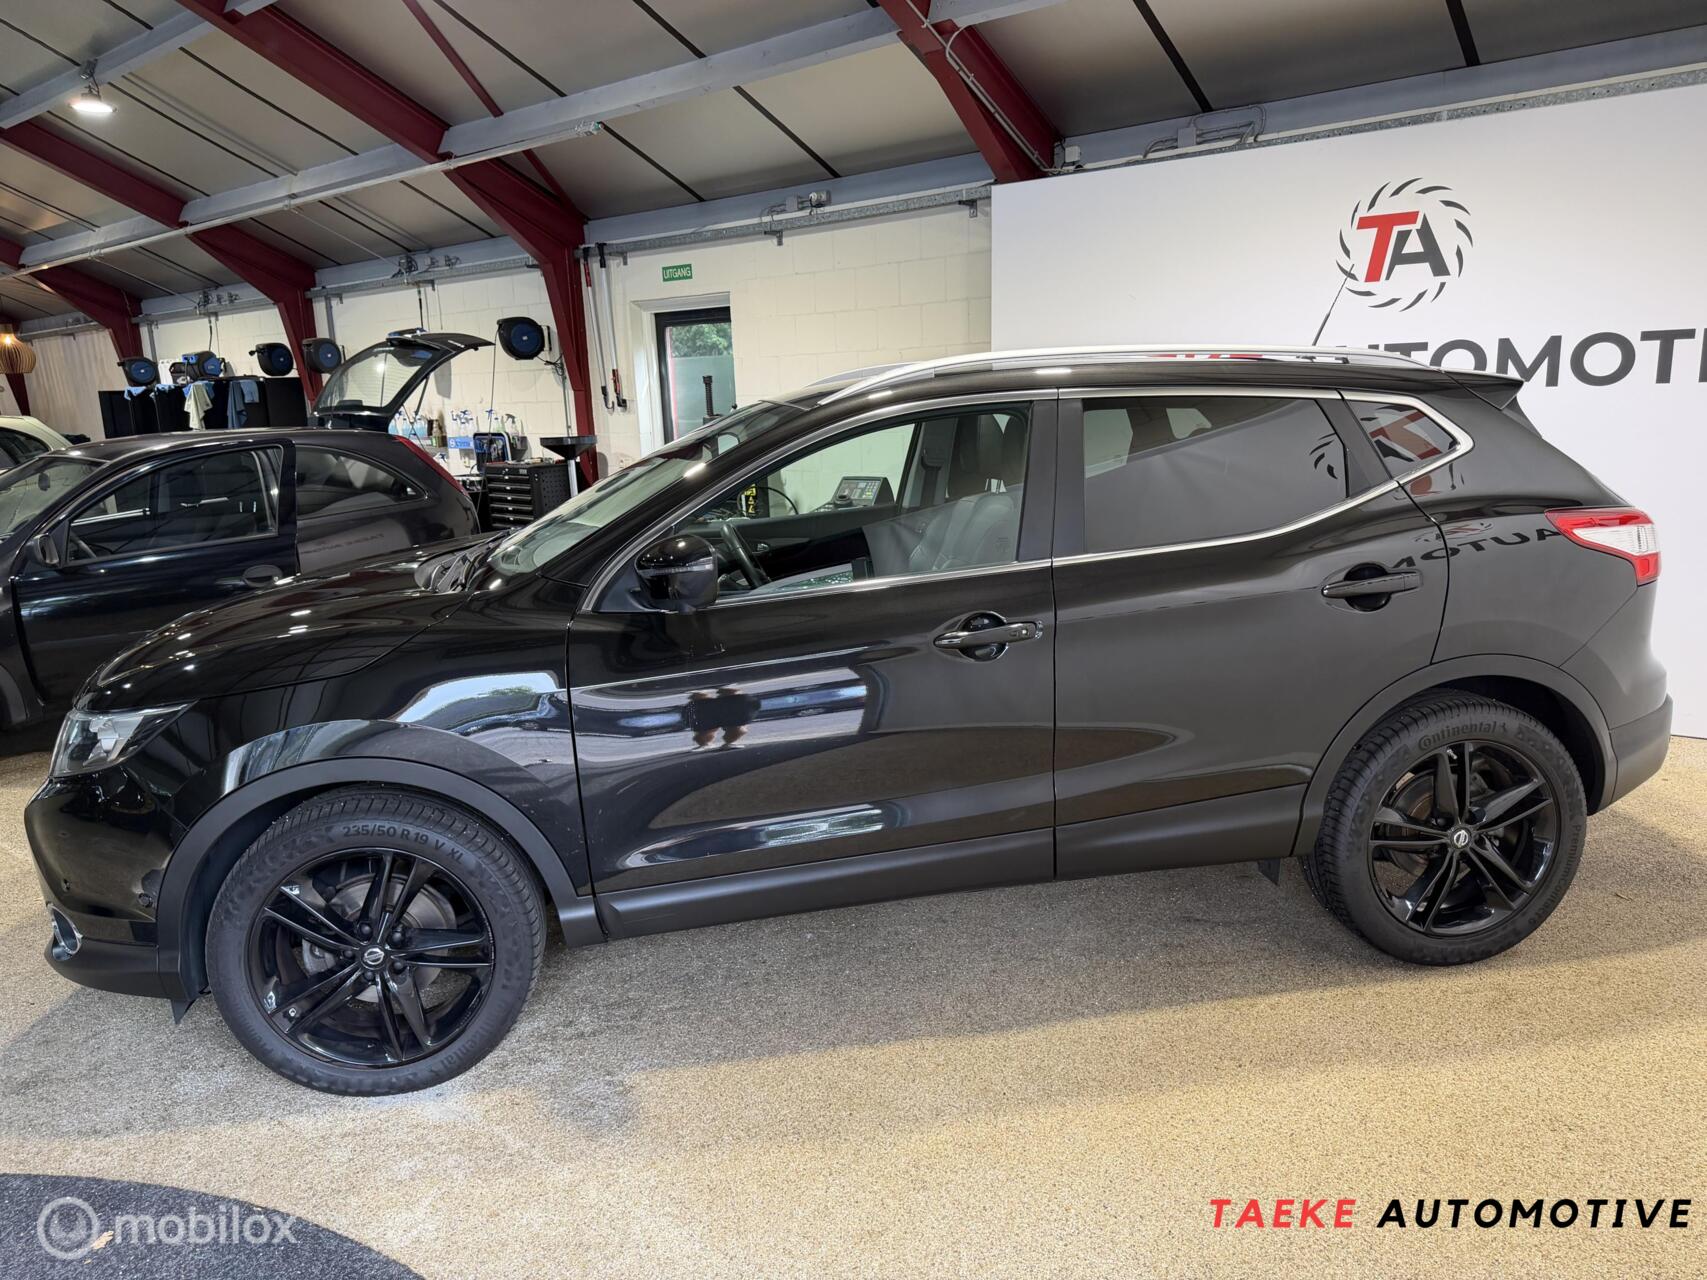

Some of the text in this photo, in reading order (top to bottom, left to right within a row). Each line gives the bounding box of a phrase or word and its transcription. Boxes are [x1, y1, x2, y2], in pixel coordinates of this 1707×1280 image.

[1356, 210, 1451, 283] TA
[663, 267, 691, 279] UITGANG
[1417, 720, 1497, 750] Continental
[342, 823, 397, 838] 235/50
